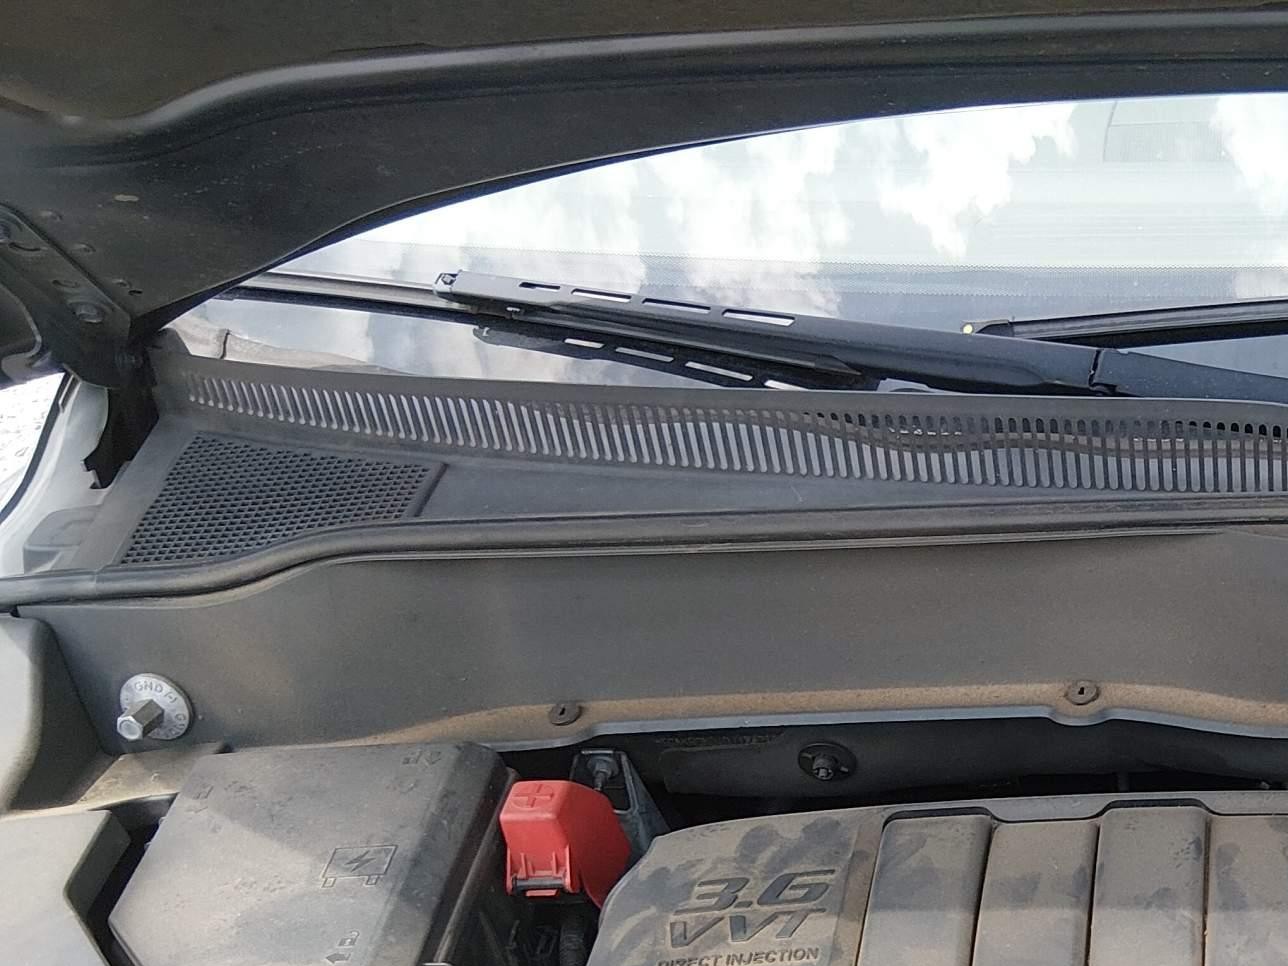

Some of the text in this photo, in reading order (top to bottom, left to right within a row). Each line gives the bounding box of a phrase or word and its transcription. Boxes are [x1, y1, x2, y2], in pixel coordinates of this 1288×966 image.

[134, 680, 164, 694] GND
[673, 869, 836, 916] 3.6
[669, 908, 827, 949] VVT
[726, 947, 820, 966] INJECTION
